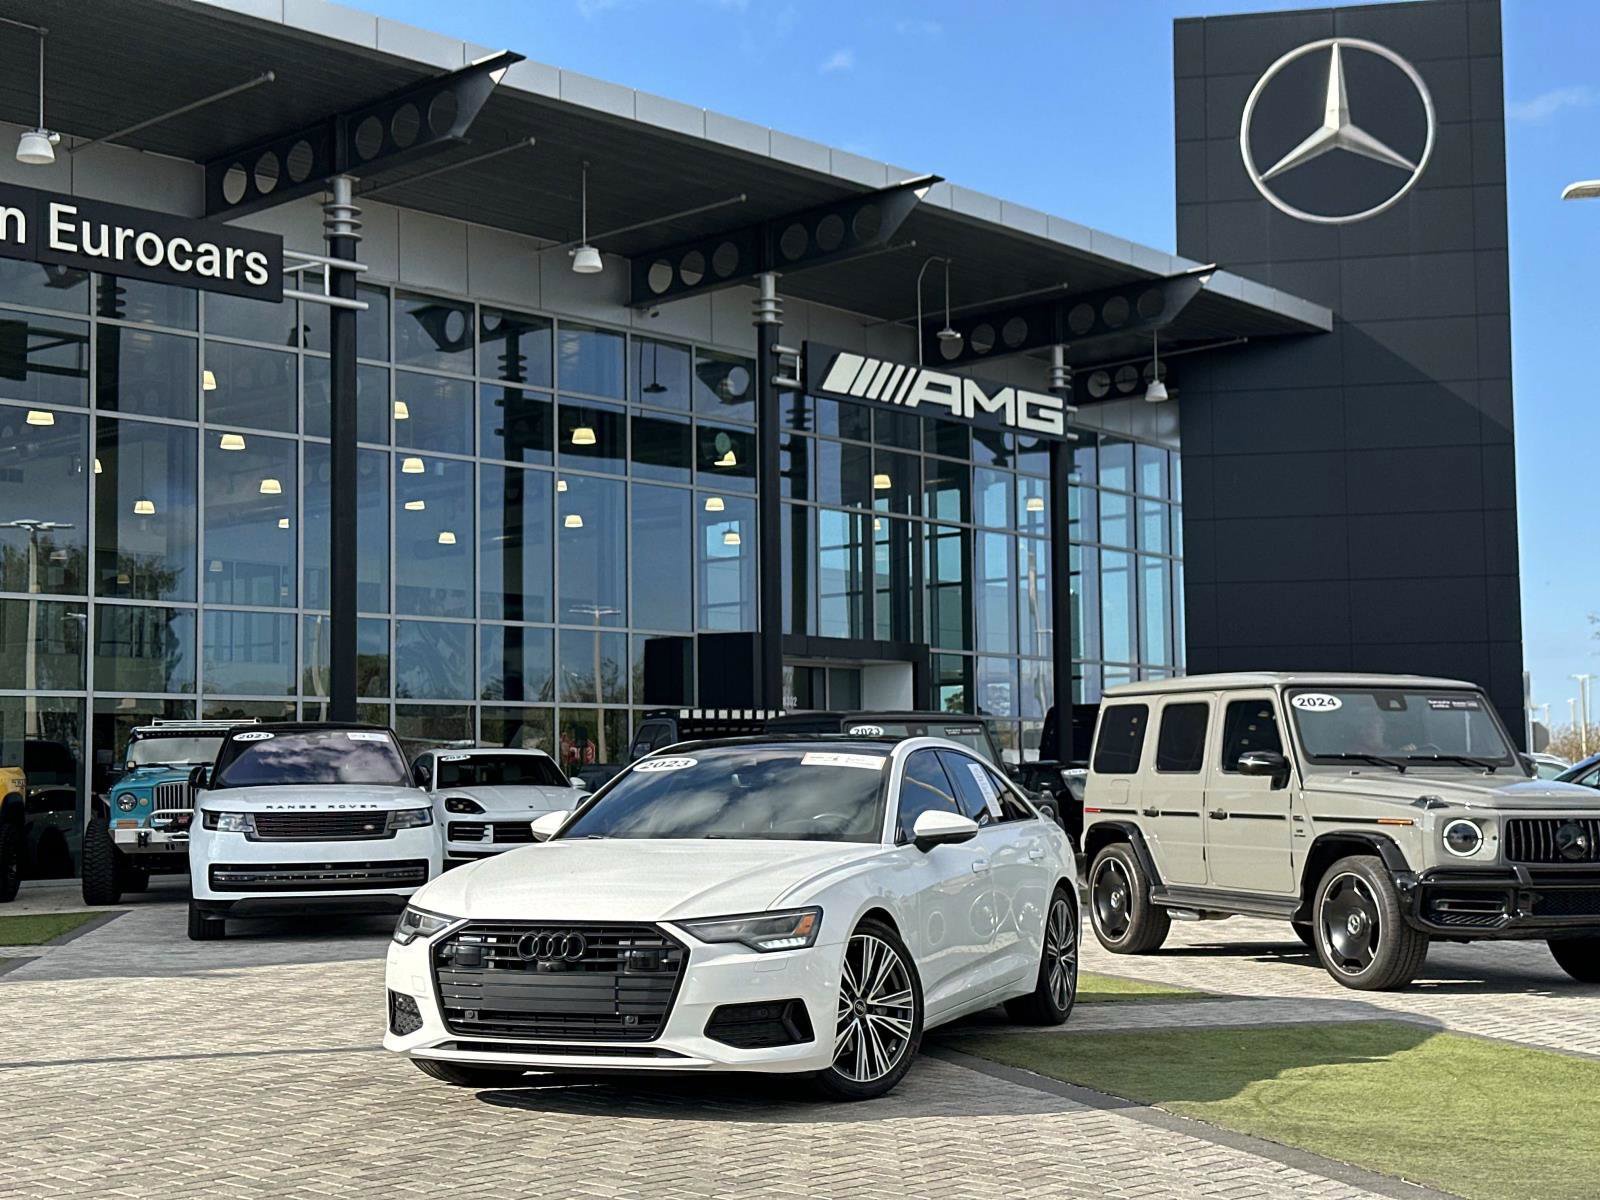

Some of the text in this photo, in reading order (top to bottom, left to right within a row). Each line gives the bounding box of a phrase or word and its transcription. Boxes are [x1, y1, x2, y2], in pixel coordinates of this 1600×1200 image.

[50, 202, 269, 286] Eurocars
[905, 369, 1064, 436] AMG
[1296, 697, 1337, 707] 2024
[639, 760, 691, 769] 2023
